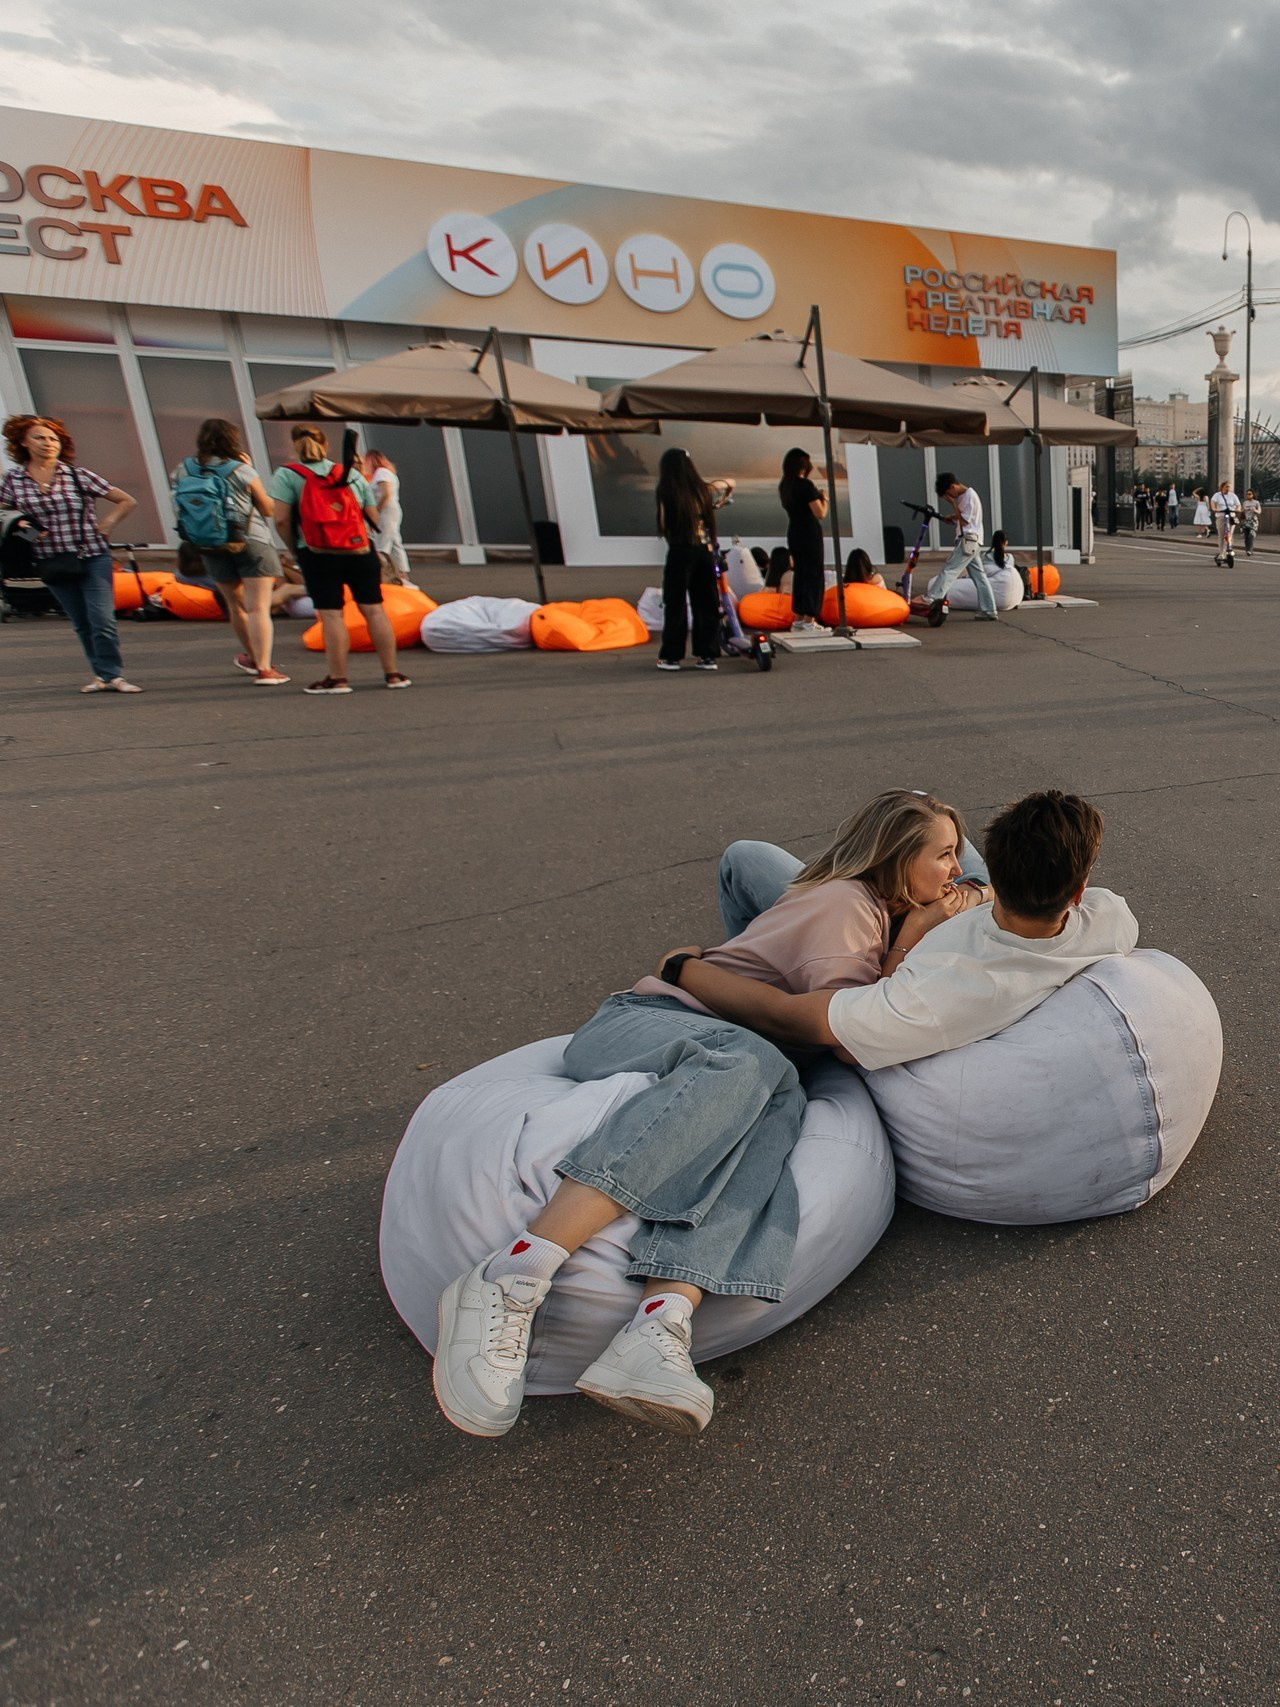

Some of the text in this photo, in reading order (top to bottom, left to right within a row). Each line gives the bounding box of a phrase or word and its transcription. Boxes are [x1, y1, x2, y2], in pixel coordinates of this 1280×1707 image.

[444, 232, 764, 300] КИНО
[904, 264, 1094, 304] РОССИЙСКАЯ
[905, 288, 1086, 324] КРЕАТИВНАЯ
[906, 310, 1022, 340] НЕДЕЛЯ
